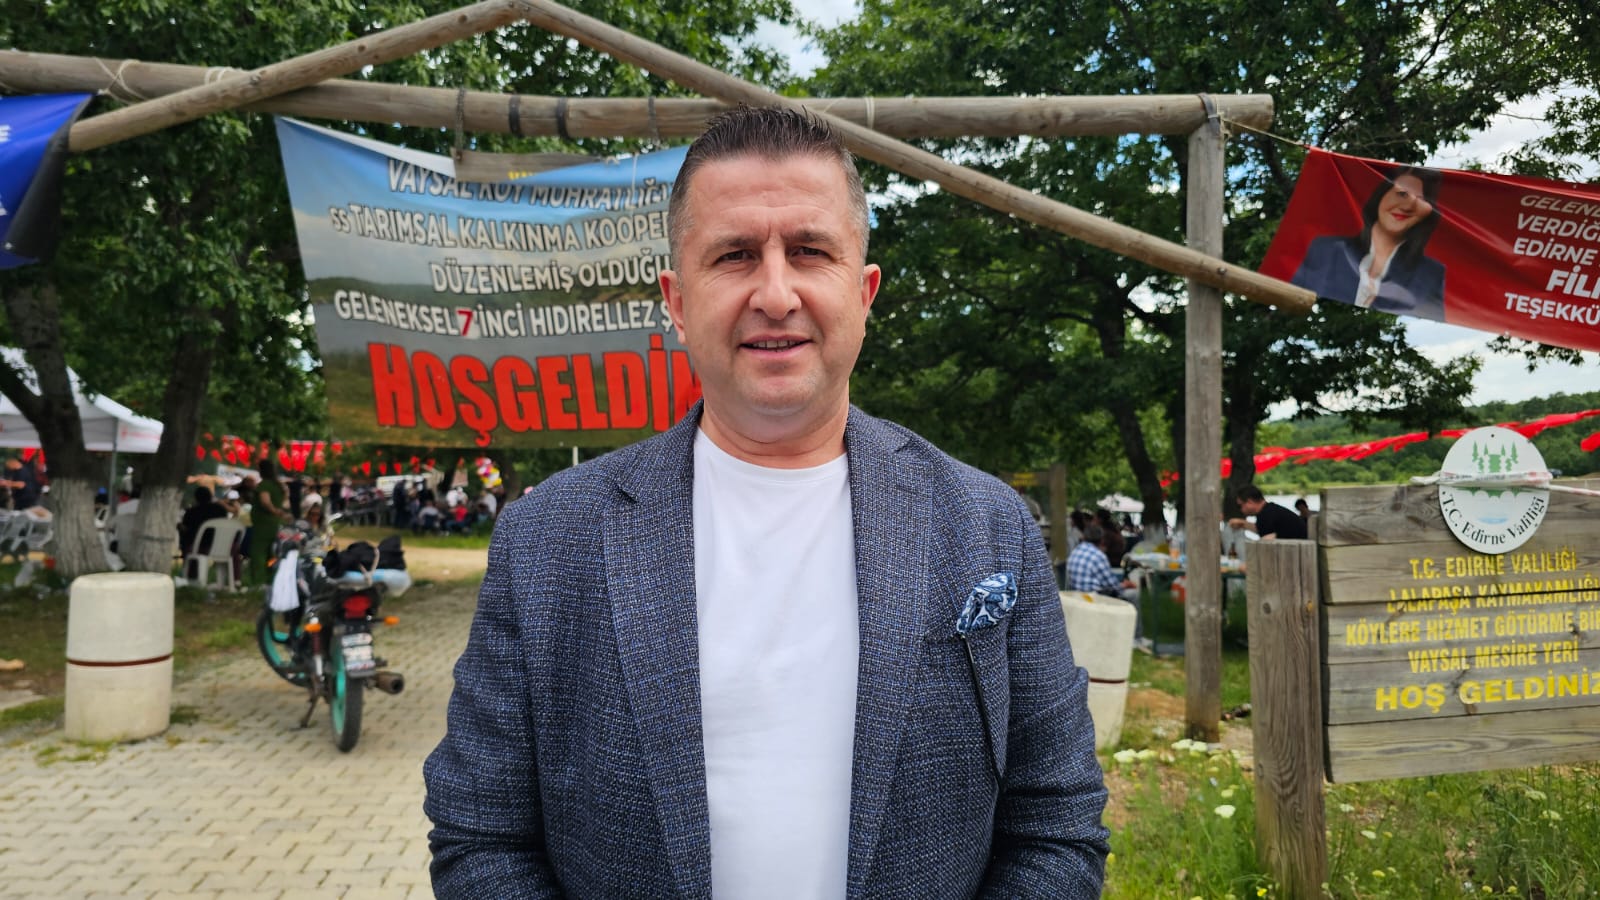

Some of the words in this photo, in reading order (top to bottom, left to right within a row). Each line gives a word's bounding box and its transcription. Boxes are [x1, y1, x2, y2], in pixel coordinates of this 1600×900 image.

[348, 203, 458, 248] TARIMSAL
[458, 216, 584, 252] KALKINMA
[583, 209, 670, 242] KOOPE
[1516, 212, 1600, 243] VERDİĞ
[1513, 237, 1597, 265] EDİRNE
[430, 257, 574, 294] DÜZENLEMİŞ
[333, 289, 459, 337] GELENEKSEL
[529, 300, 656, 338] HIDIRELLEZ
[1461, 521, 1507, 545] Edirne
[1507, 496, 1545, 539] Valiliği
[1386, 585, 1472, 616] LALAPAŞA
[1345, 618, 1421, 647] KÖYLERE
[1426, 614, 1490, 642] HİZMET
[1494, 609, 1575, 637] GÖTÜRME
[1407, 648, 1470, 674] VAYSAL
[1474, 639, 1537, 669] MESİRE
[1542, 635, 1579, 664] YERİ
[1375, 681, 1447, 714] HOŞ
[1459, 667, 1600, 705] GELDİNİZ
